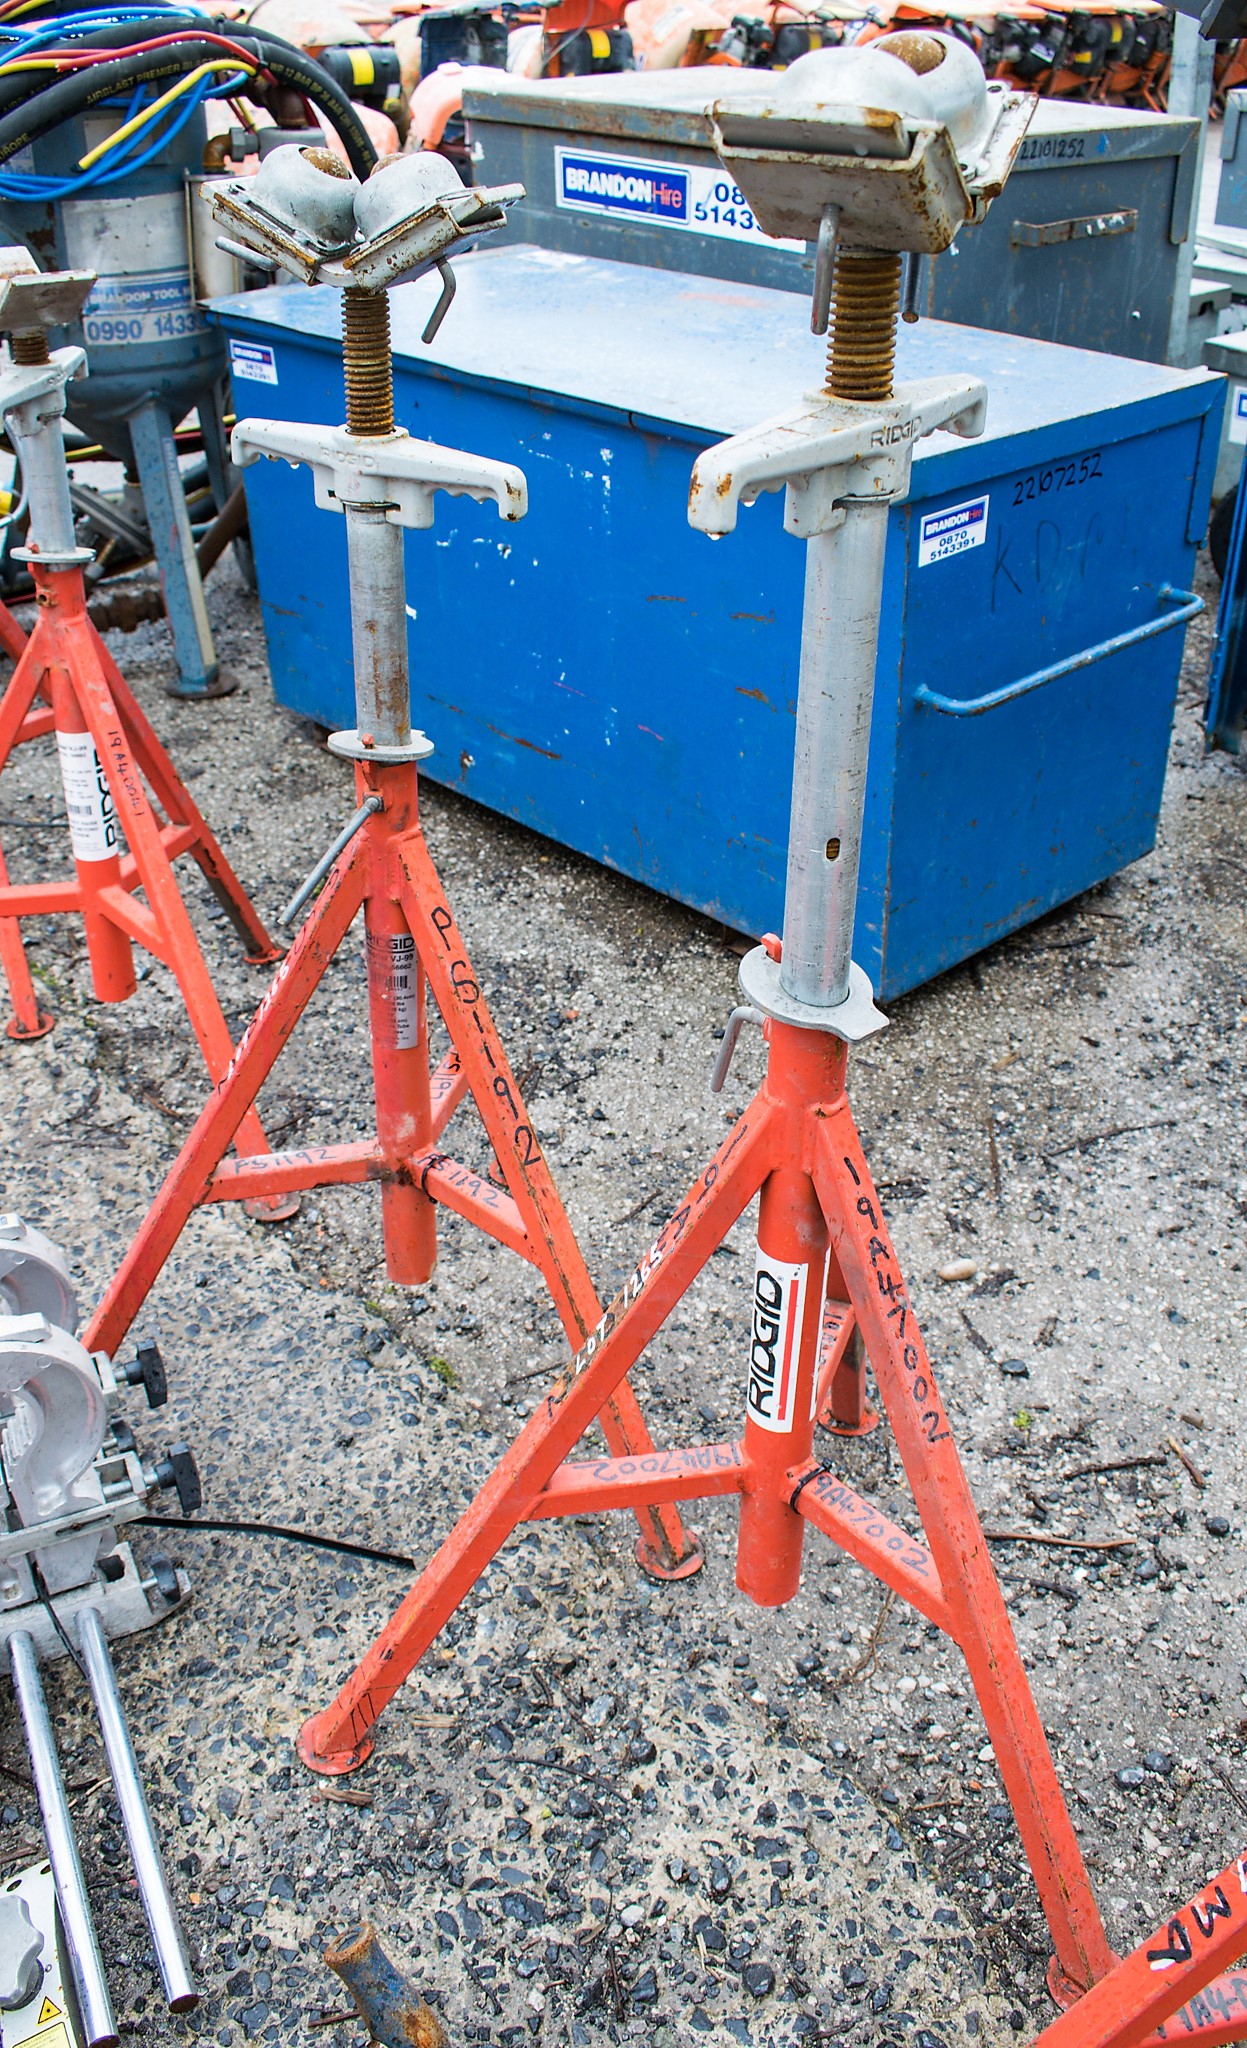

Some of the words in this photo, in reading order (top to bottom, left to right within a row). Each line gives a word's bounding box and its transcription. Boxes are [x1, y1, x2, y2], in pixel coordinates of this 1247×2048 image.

[137, 62, 181, 82] PREMIER
[714, 182, 745, 205] 08
[695, 202, 763, 232] 5143
[154, 287, 180, 300] TOOL
[86, 319, 143, 341] 0990
[154, 313, 197, 337] 1433
[930, 537, 976, 561] 5143391
[939, 530, 968, 548] 0870
[843, 1156, 951, 1445] 19A47002
[747, 1267, 784, 1420] RIDGID
[813, 1475, 929, 1577] 9A47002
